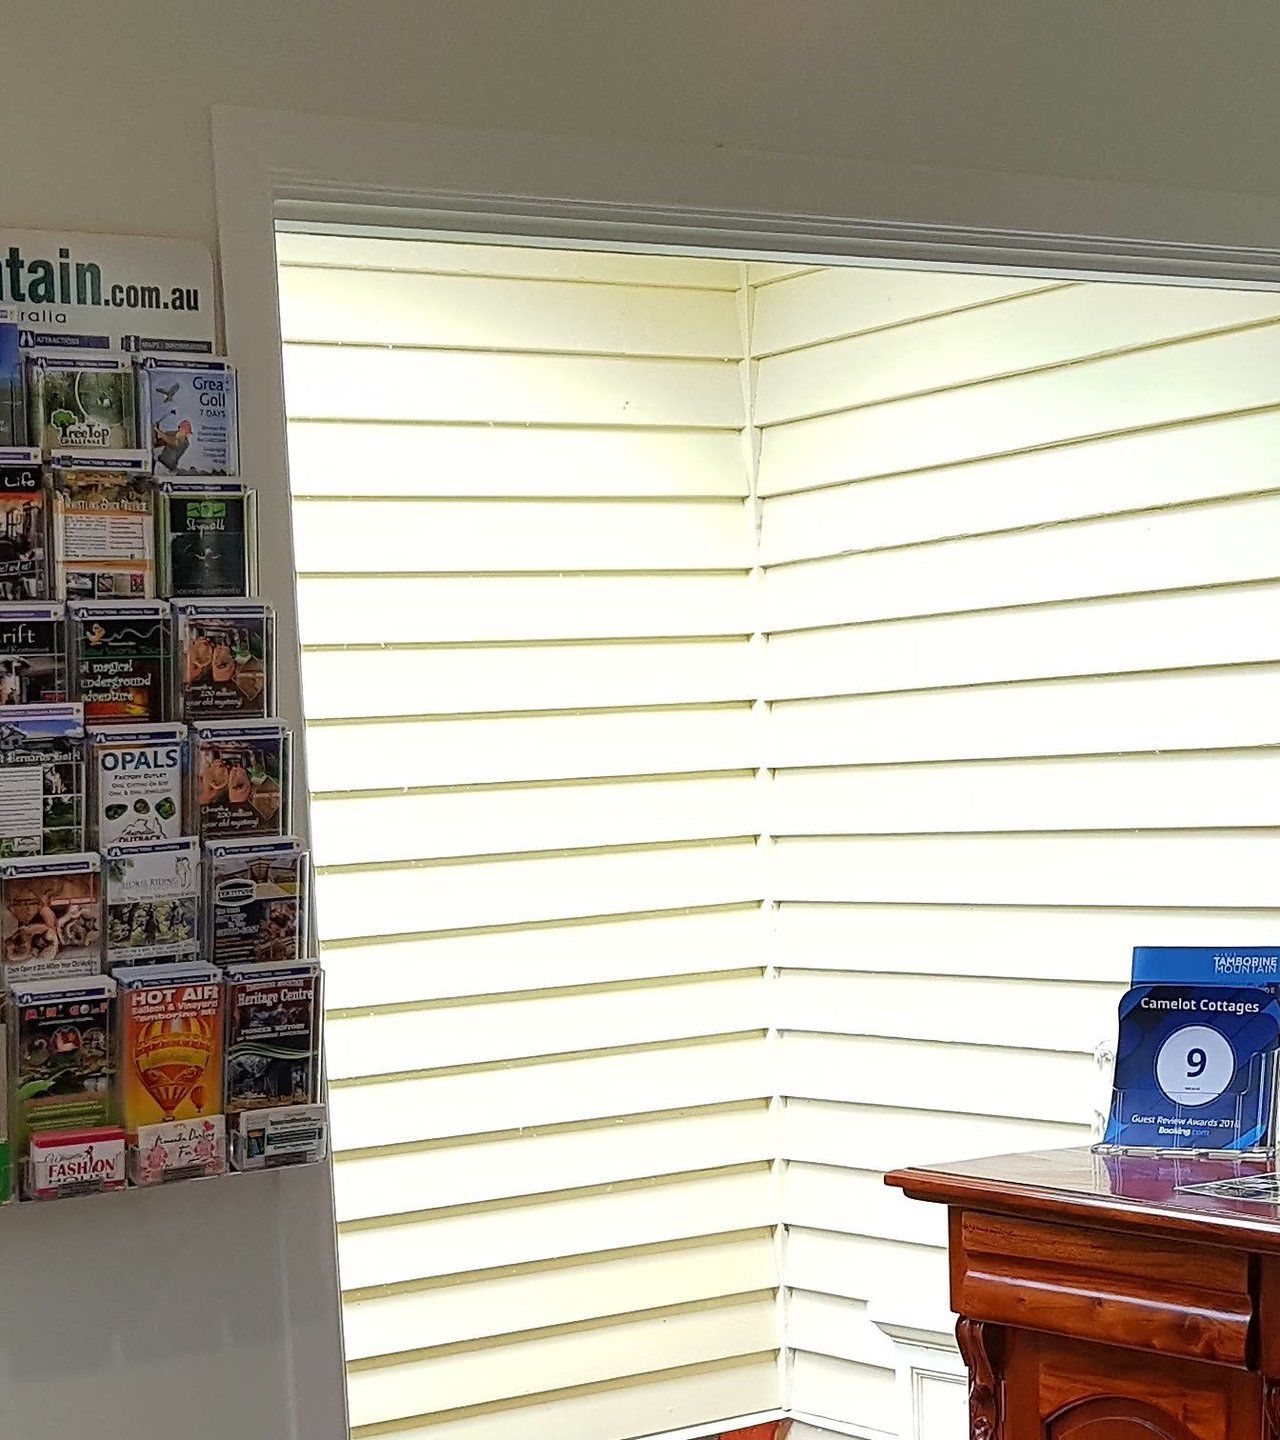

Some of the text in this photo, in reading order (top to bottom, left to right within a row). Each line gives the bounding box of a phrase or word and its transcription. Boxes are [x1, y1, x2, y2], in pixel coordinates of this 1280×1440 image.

[21, 309, 67, 323] ralia
[5, 472, 35, 488] Life
[101, 749, 179, 771] OPALS
[1212, 956, 1279, 967] TAMBORINE
[1214, 964, 1278, 975] MOUNTAIN
[132, 985, 219, 1006] HOT AIR
[238, 988, 314, 1007] Heritage Centre
[1140, 997, 1260, 1015] Camelot Cottages
[1185, 1047, 1208, 1079] 9
[1131, 1114, 1218, 1127] Guest Review Awards
[48, 1159, 115, 1179] FASHION
